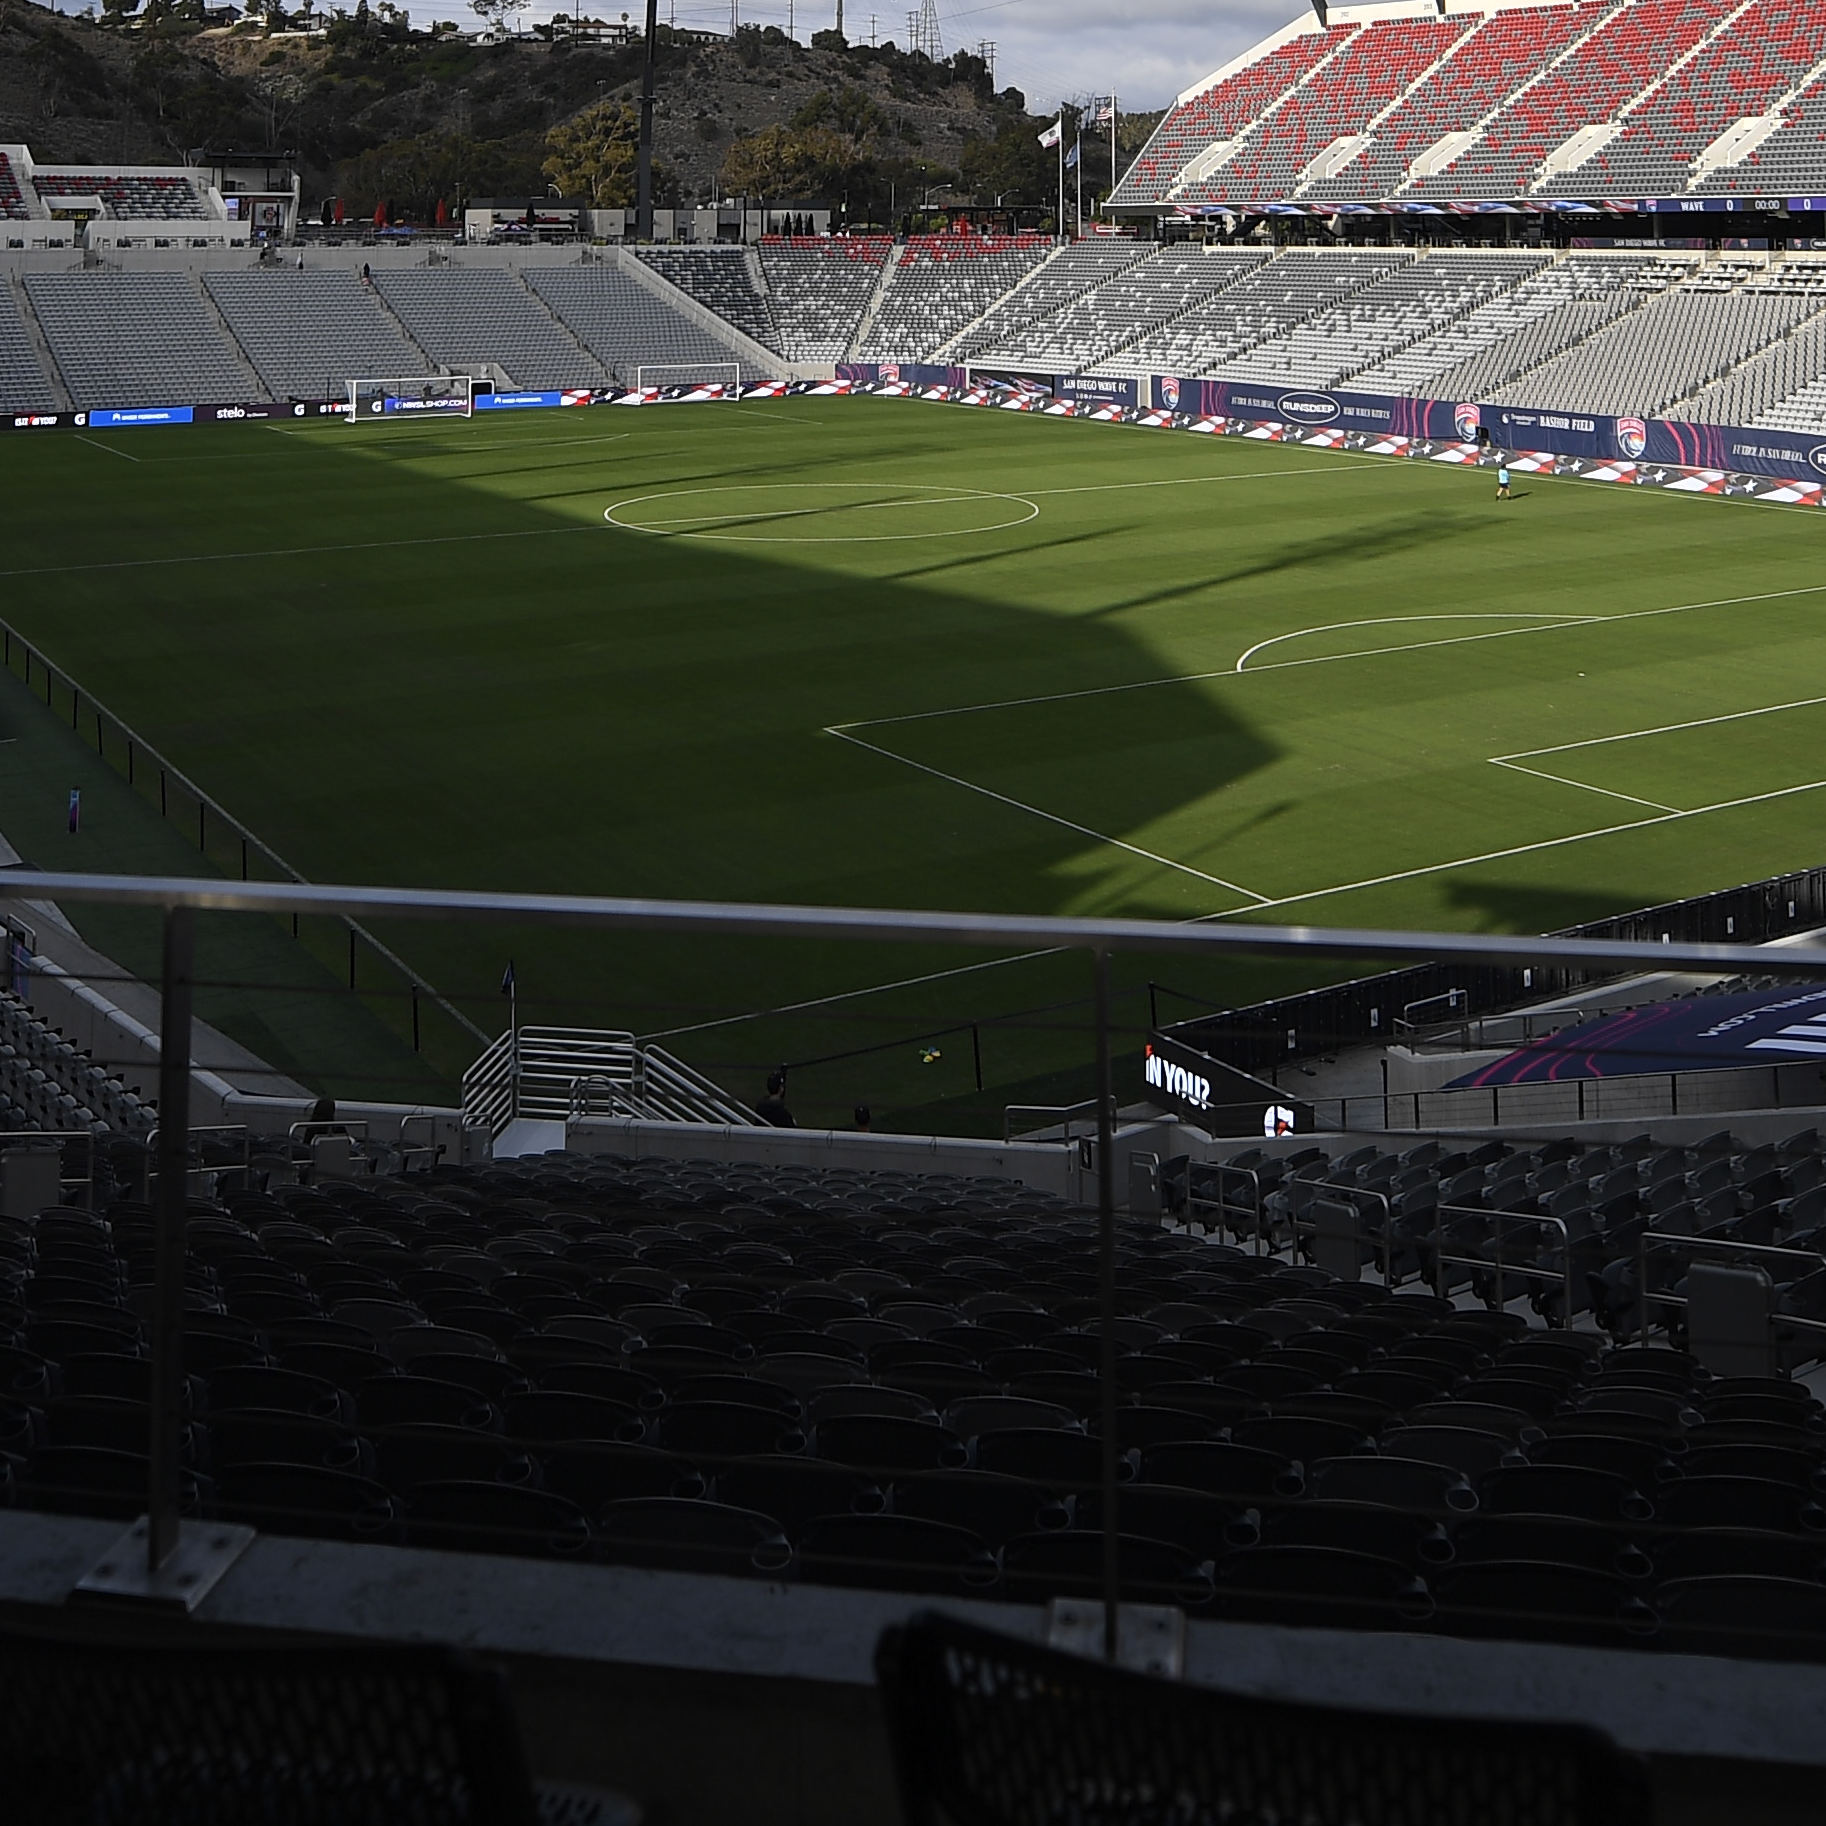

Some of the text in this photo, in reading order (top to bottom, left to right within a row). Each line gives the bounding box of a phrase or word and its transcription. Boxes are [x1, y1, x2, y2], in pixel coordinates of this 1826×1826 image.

[1681, 201, 1705, 212] WAVE
[1726, 200, 1734, 212] 0
[1803, 199, 1811, 210] 0
[217, 406, 246, 418] stelo
[1571, 418, 1595, 432] FIELD
[1145, 1052, 1211, 1111] IN YOU?
